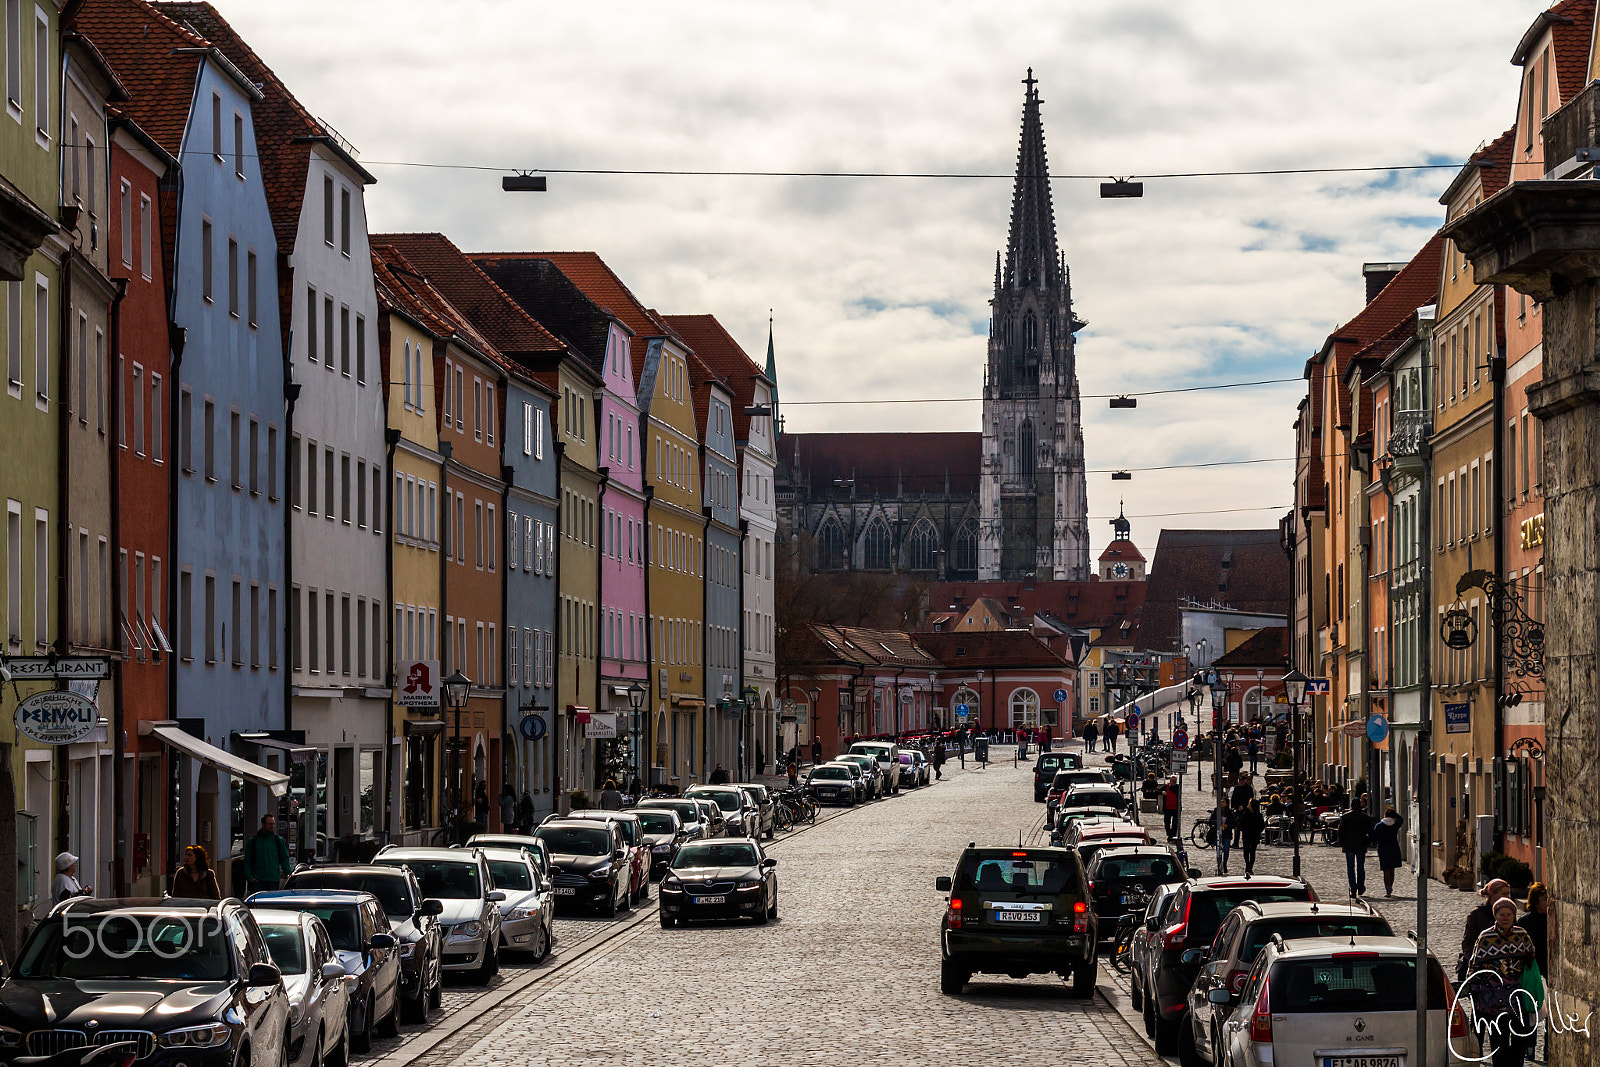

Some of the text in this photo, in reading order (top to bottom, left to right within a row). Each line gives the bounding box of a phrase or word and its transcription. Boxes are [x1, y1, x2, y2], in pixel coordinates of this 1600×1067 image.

[10, 663, 103, 673] RESTAURANT
[30, 695, 83, 707] GRIECHISCHE
[22, 708, 91, 723] PERIVOLI
[1370, 1058, 1396, 1067] 9876
